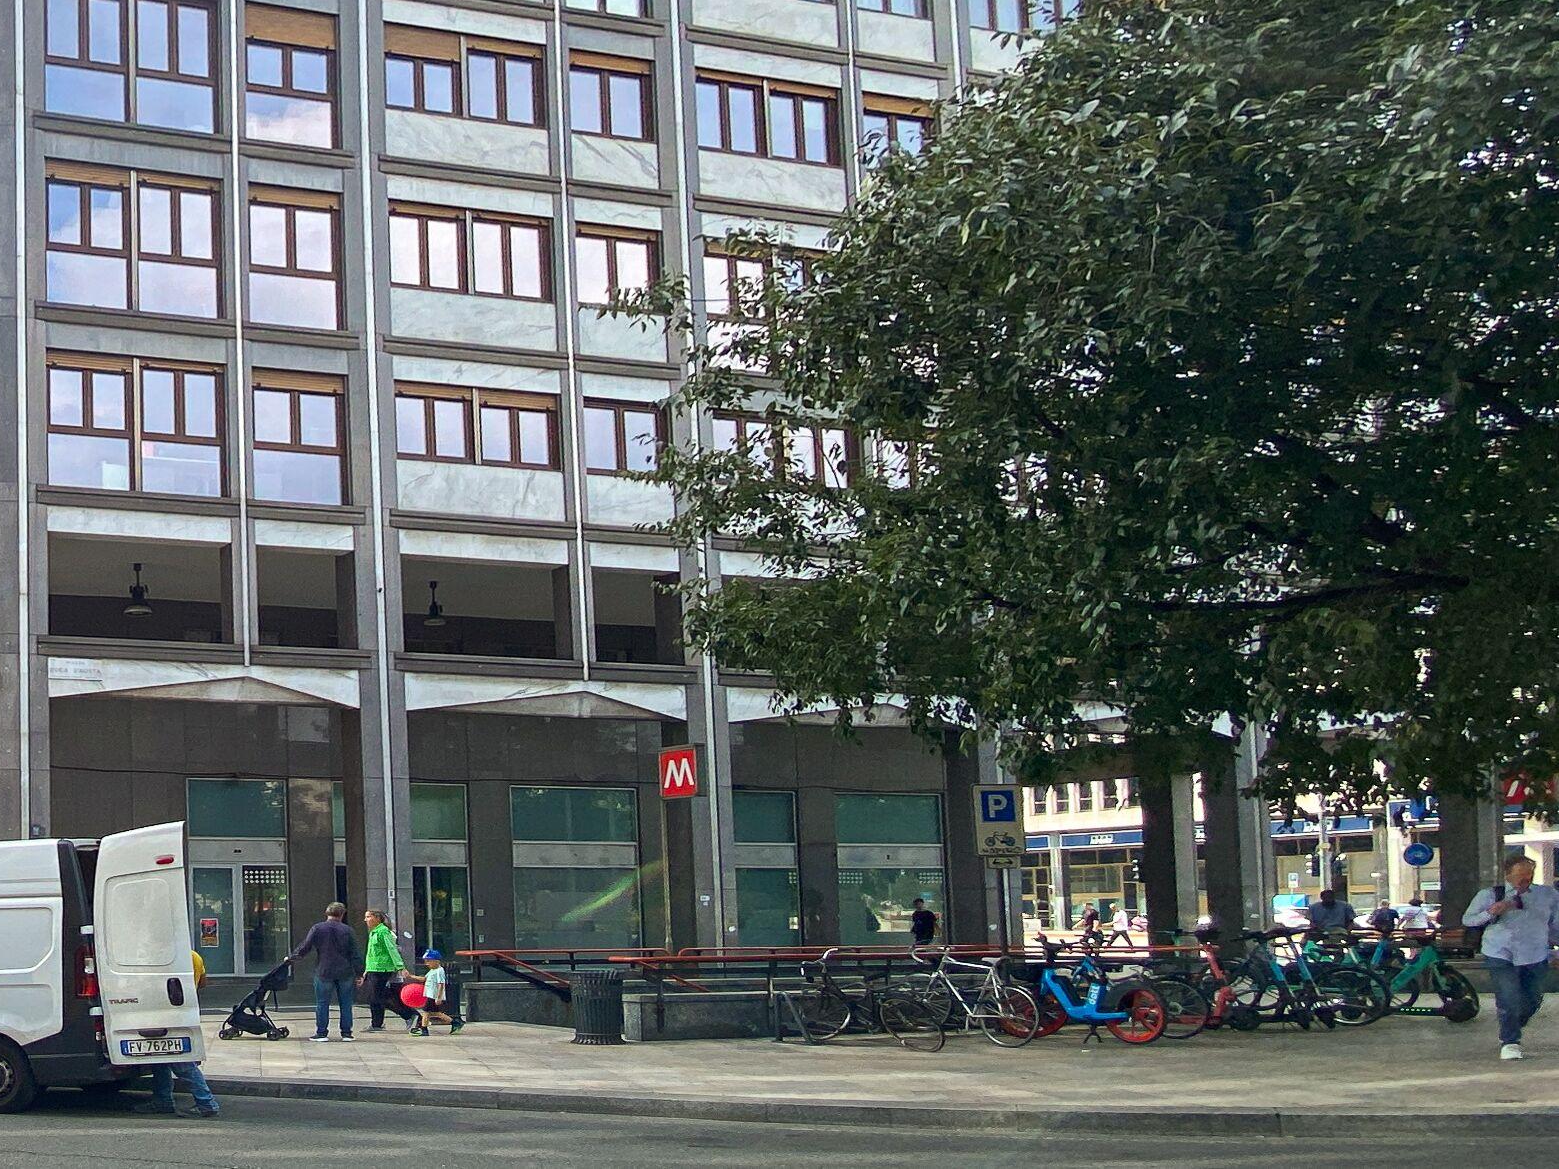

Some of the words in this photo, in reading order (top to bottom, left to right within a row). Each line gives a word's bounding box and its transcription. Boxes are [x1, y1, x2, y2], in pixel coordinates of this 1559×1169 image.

[663, 757, 695, 789] M
[988, 794, 1008, 818] P
[129, 1042, 142, 1053] FV
[146, 1039, 182, 1052] 762PH
